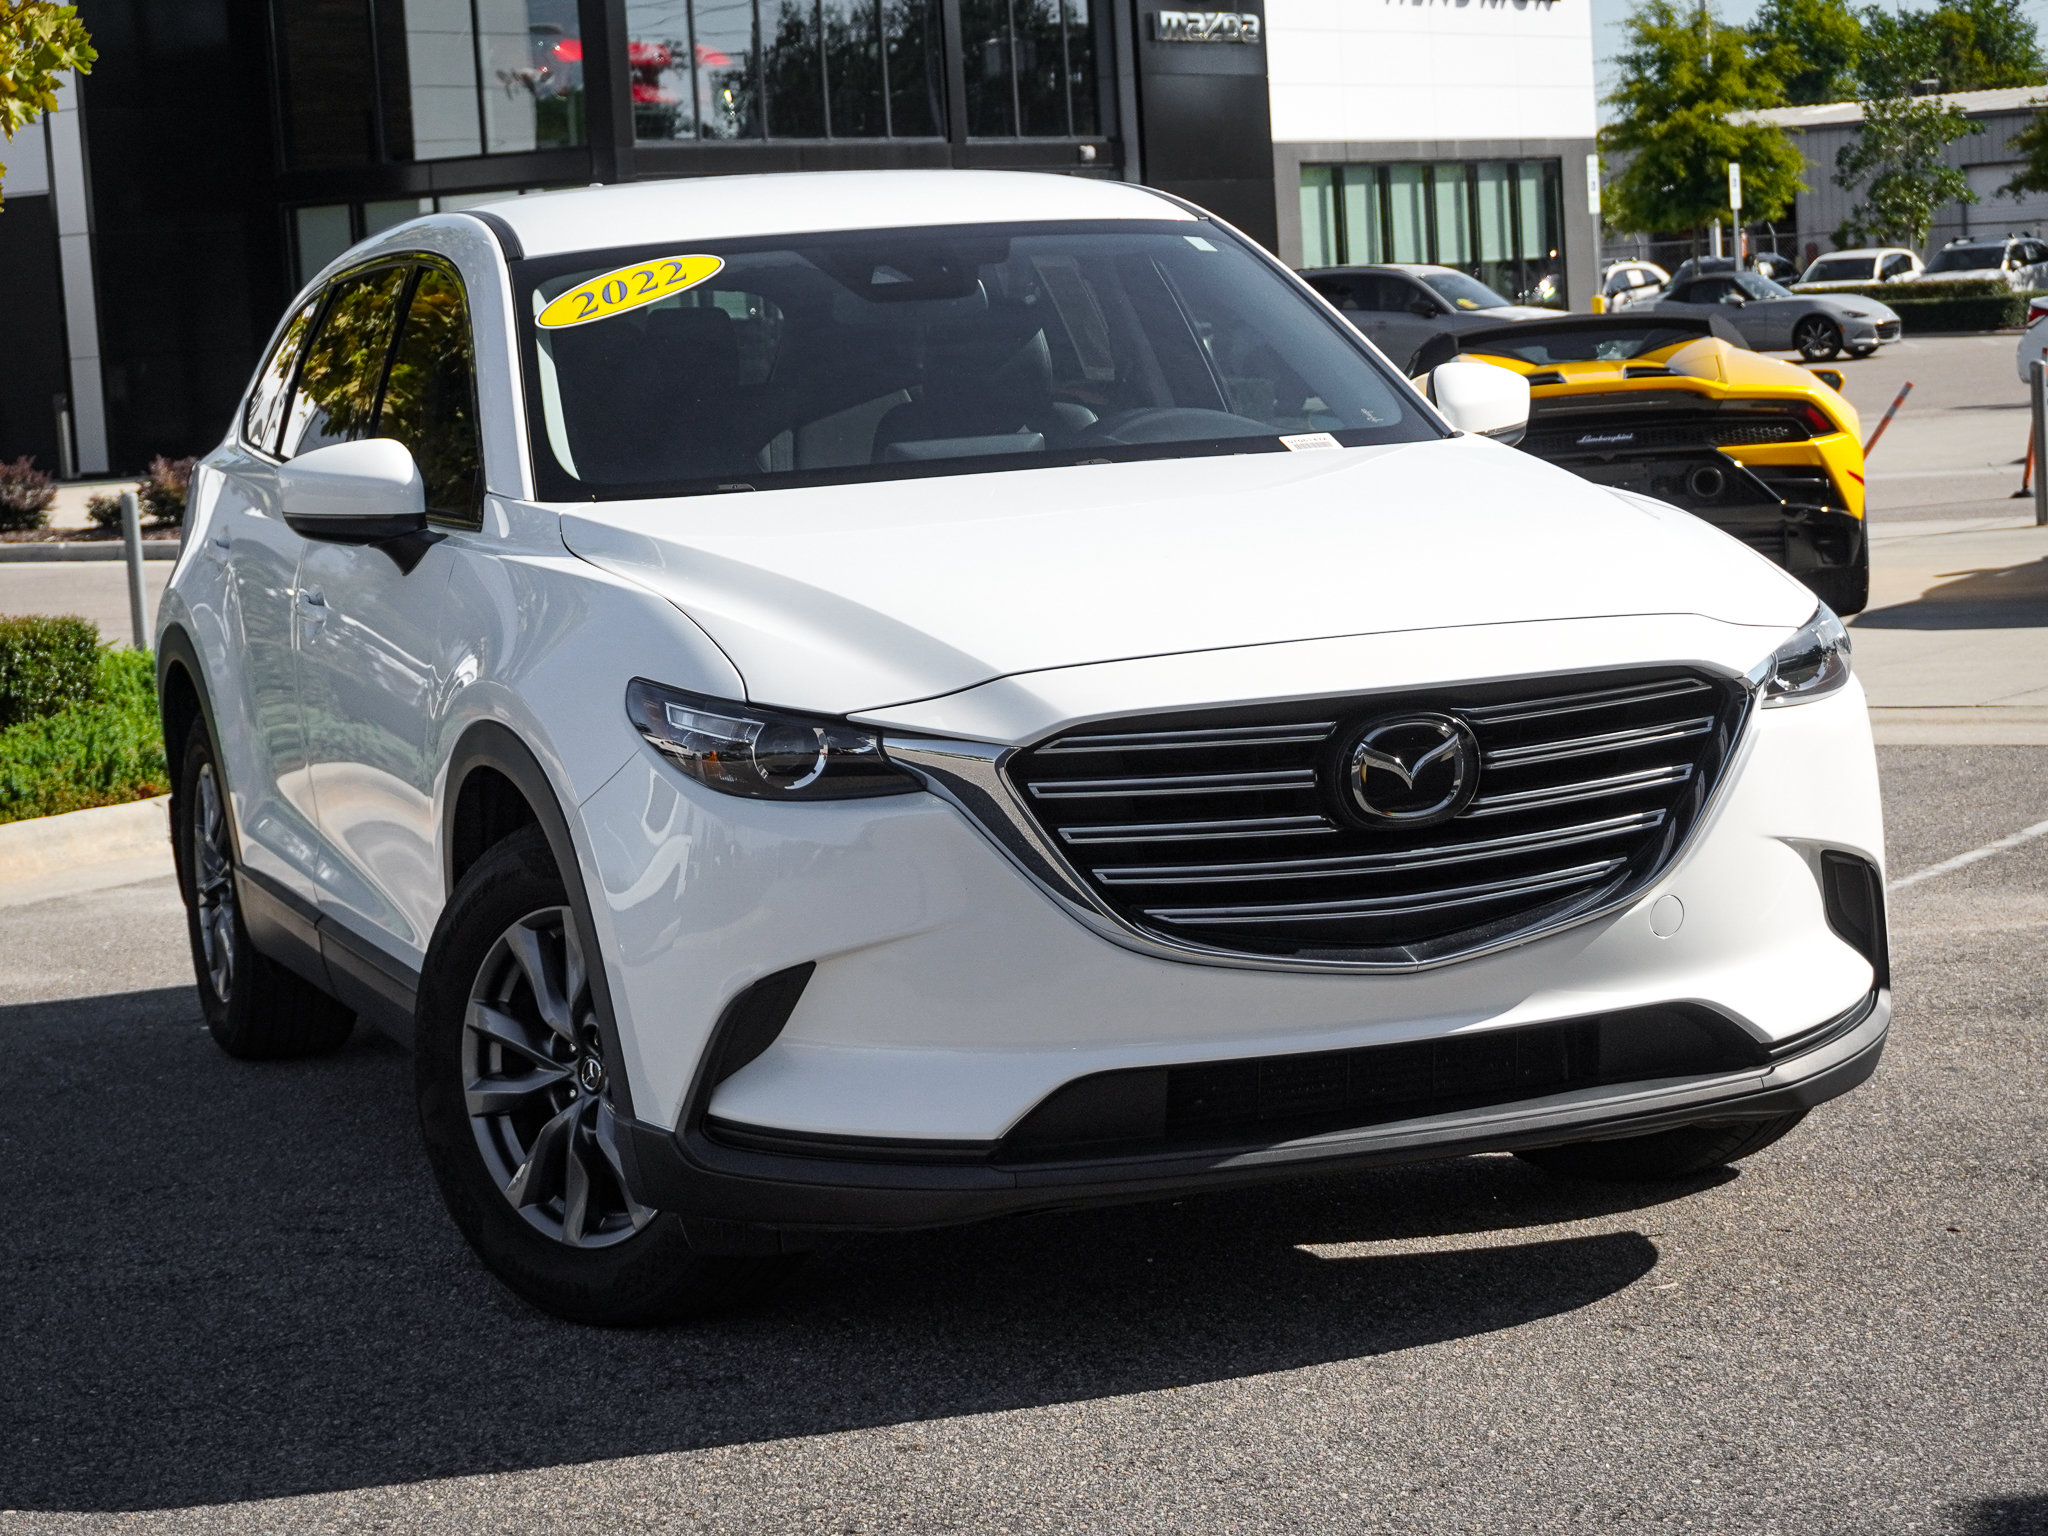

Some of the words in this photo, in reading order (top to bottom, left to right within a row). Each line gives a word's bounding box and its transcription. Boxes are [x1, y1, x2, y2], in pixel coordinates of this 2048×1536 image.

[1158, 10, 1260, 42] mazda
[572, 261, 687, 319] 2022
[1576, 432, 1634, 444] Lamborghini
